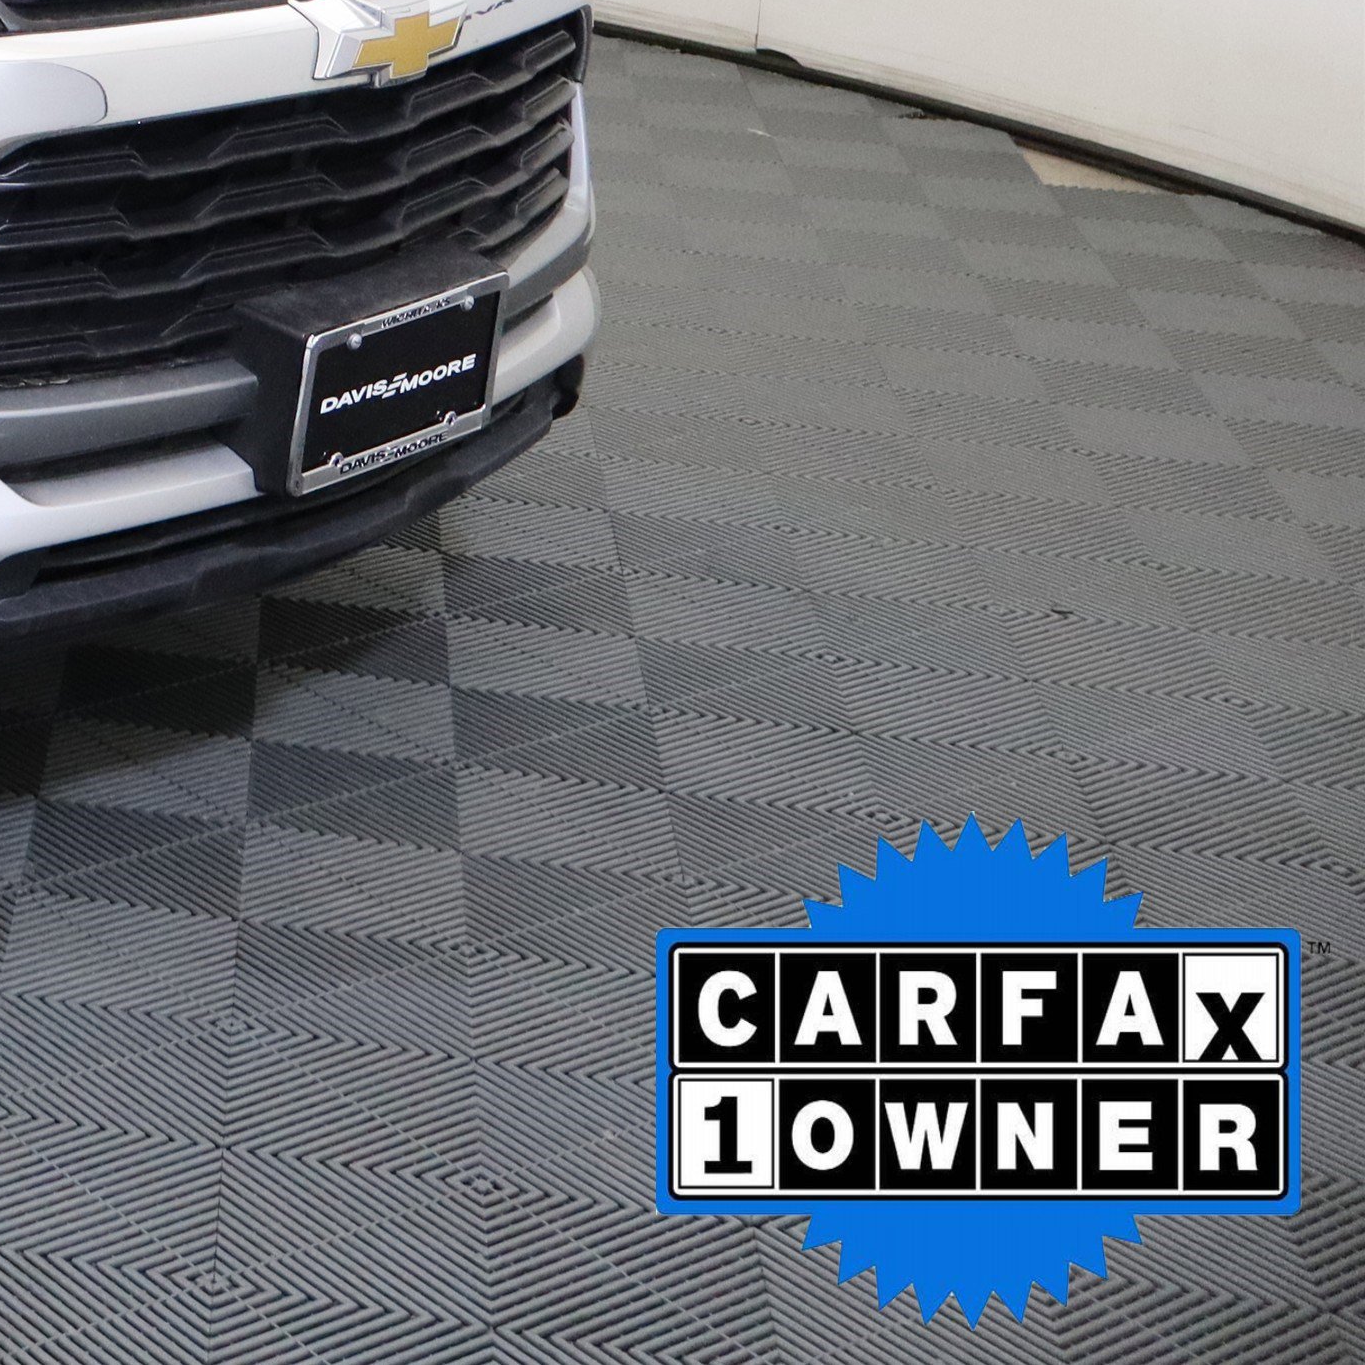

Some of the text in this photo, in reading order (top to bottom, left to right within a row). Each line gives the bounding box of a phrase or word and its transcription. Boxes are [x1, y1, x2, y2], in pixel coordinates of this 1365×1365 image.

[320, 353, 476, 414] DAVIS MOORE
[340, 431, 449, 475] DAVIS MOORE
